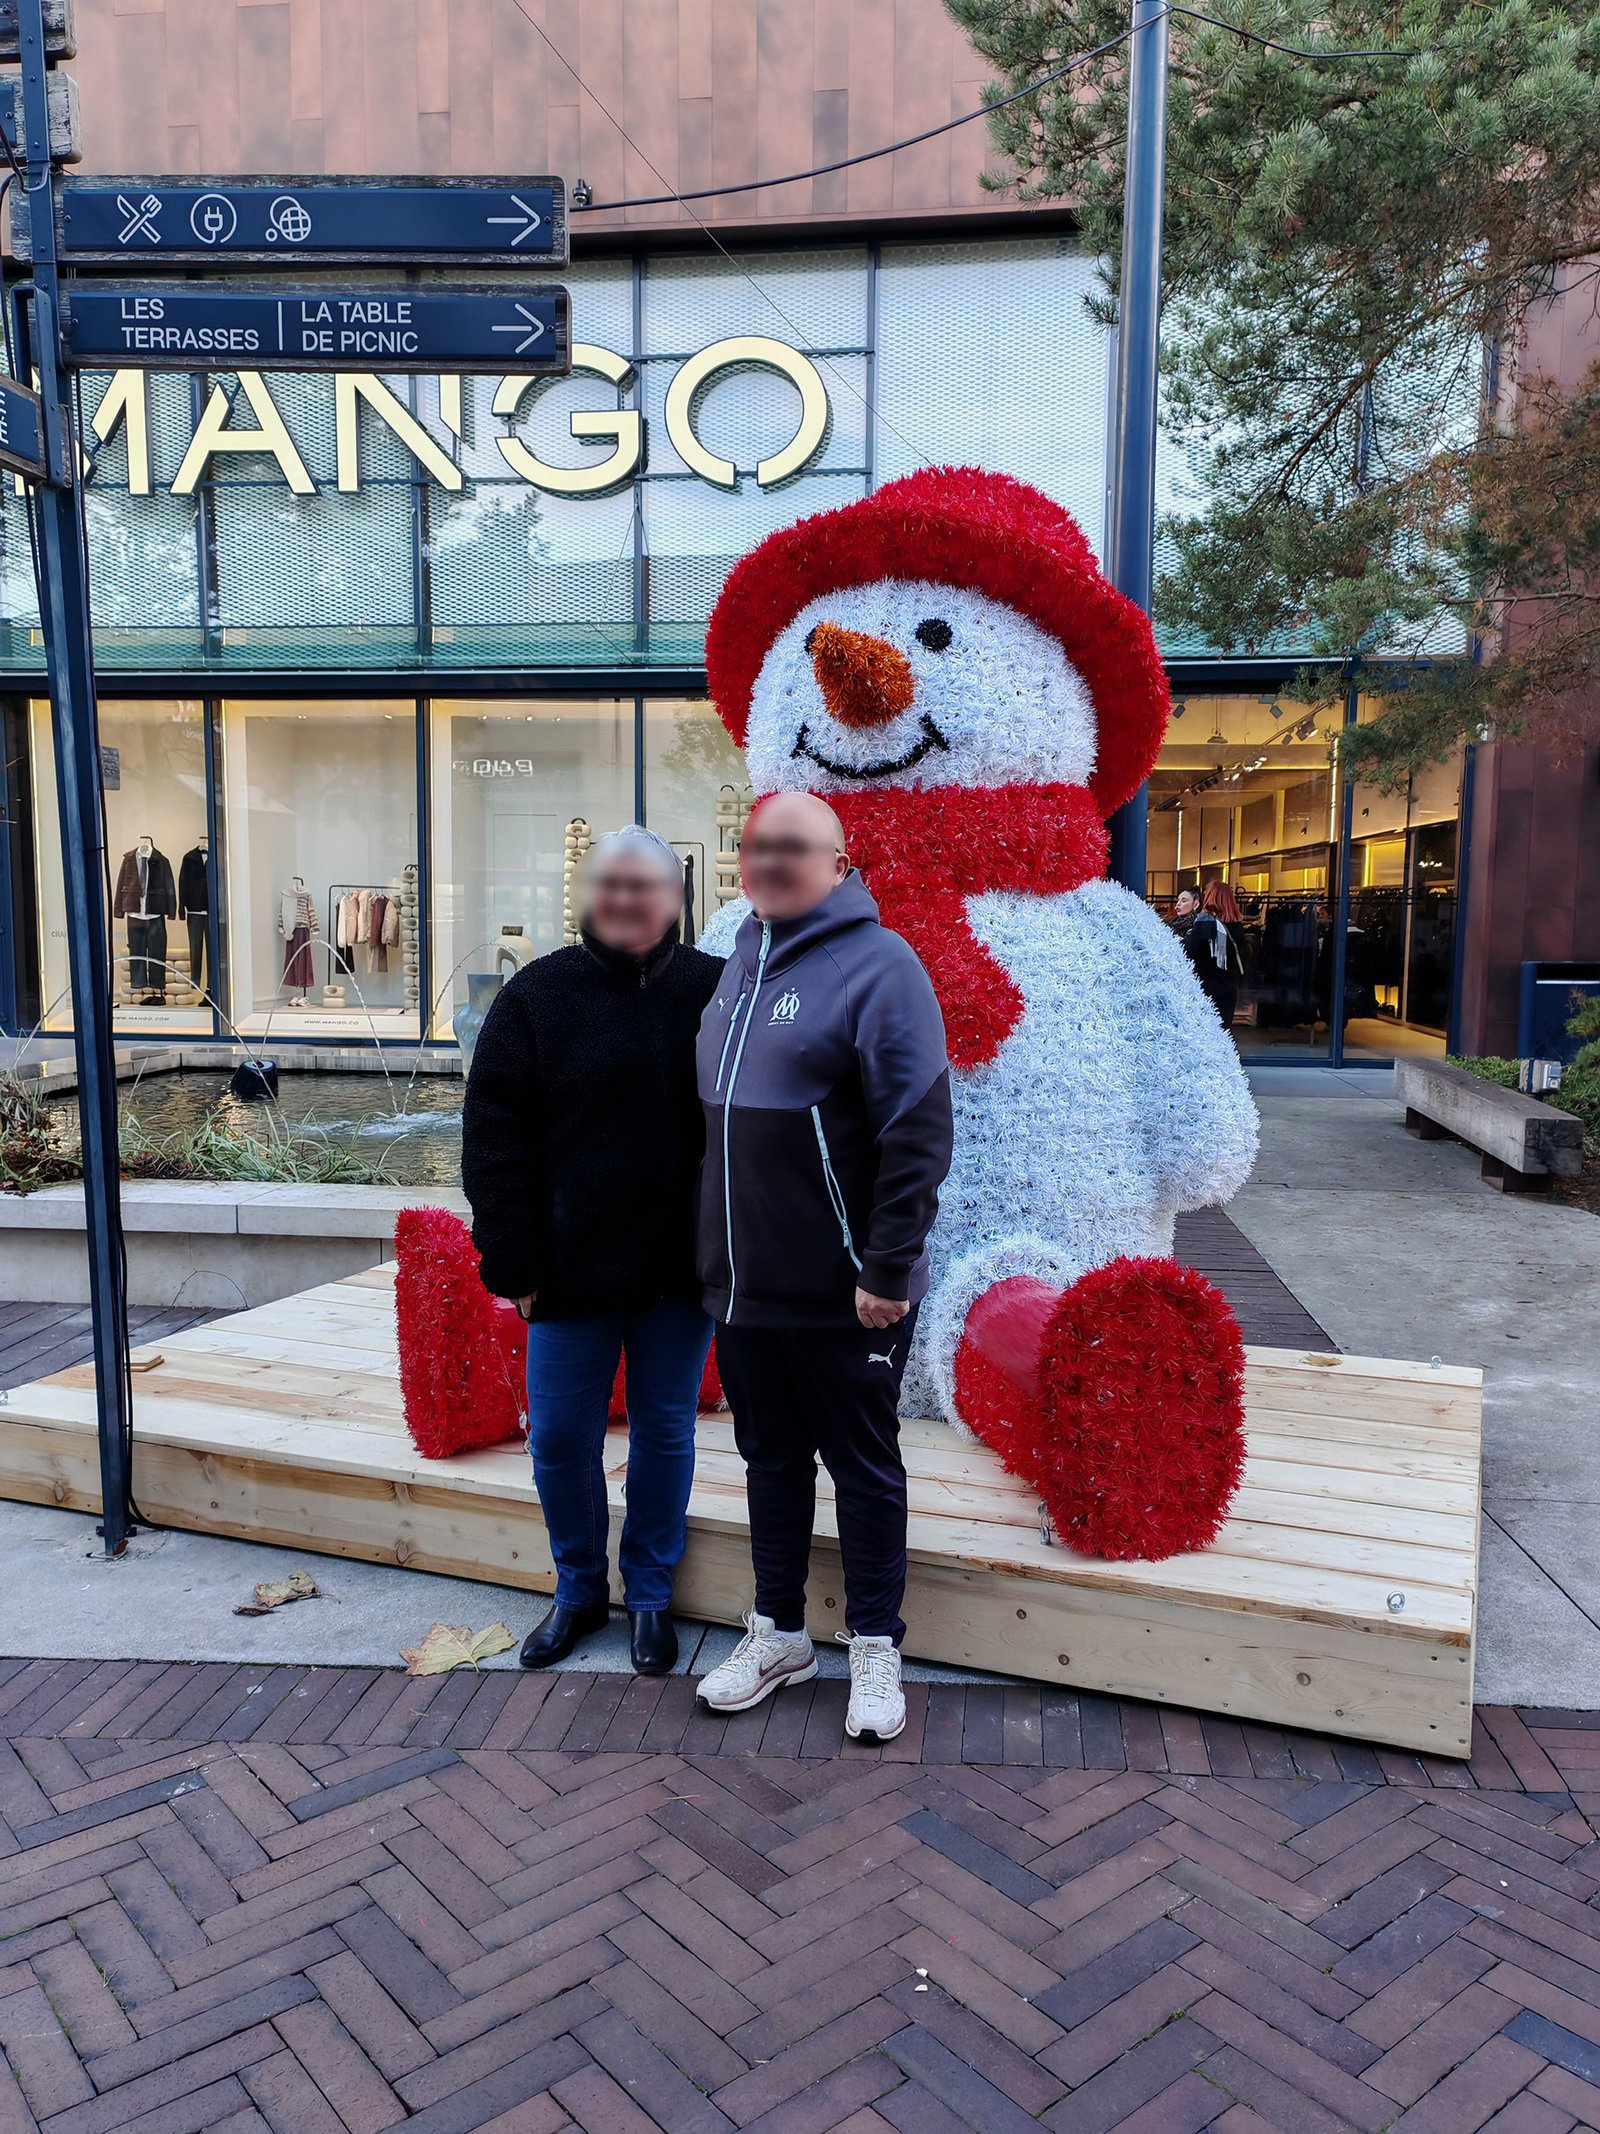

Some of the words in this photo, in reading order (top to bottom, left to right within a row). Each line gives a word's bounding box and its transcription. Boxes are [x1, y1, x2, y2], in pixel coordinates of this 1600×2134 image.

[121, 298, 164, 319] LES
[301, 301, 332, 323] LA
[338, 302, 412, 324] TABLE
[121, 326, 260, 351] TERRASSES
[302, 331, 333, 351] DE
[340, 331, 419, 353] PICNIC
